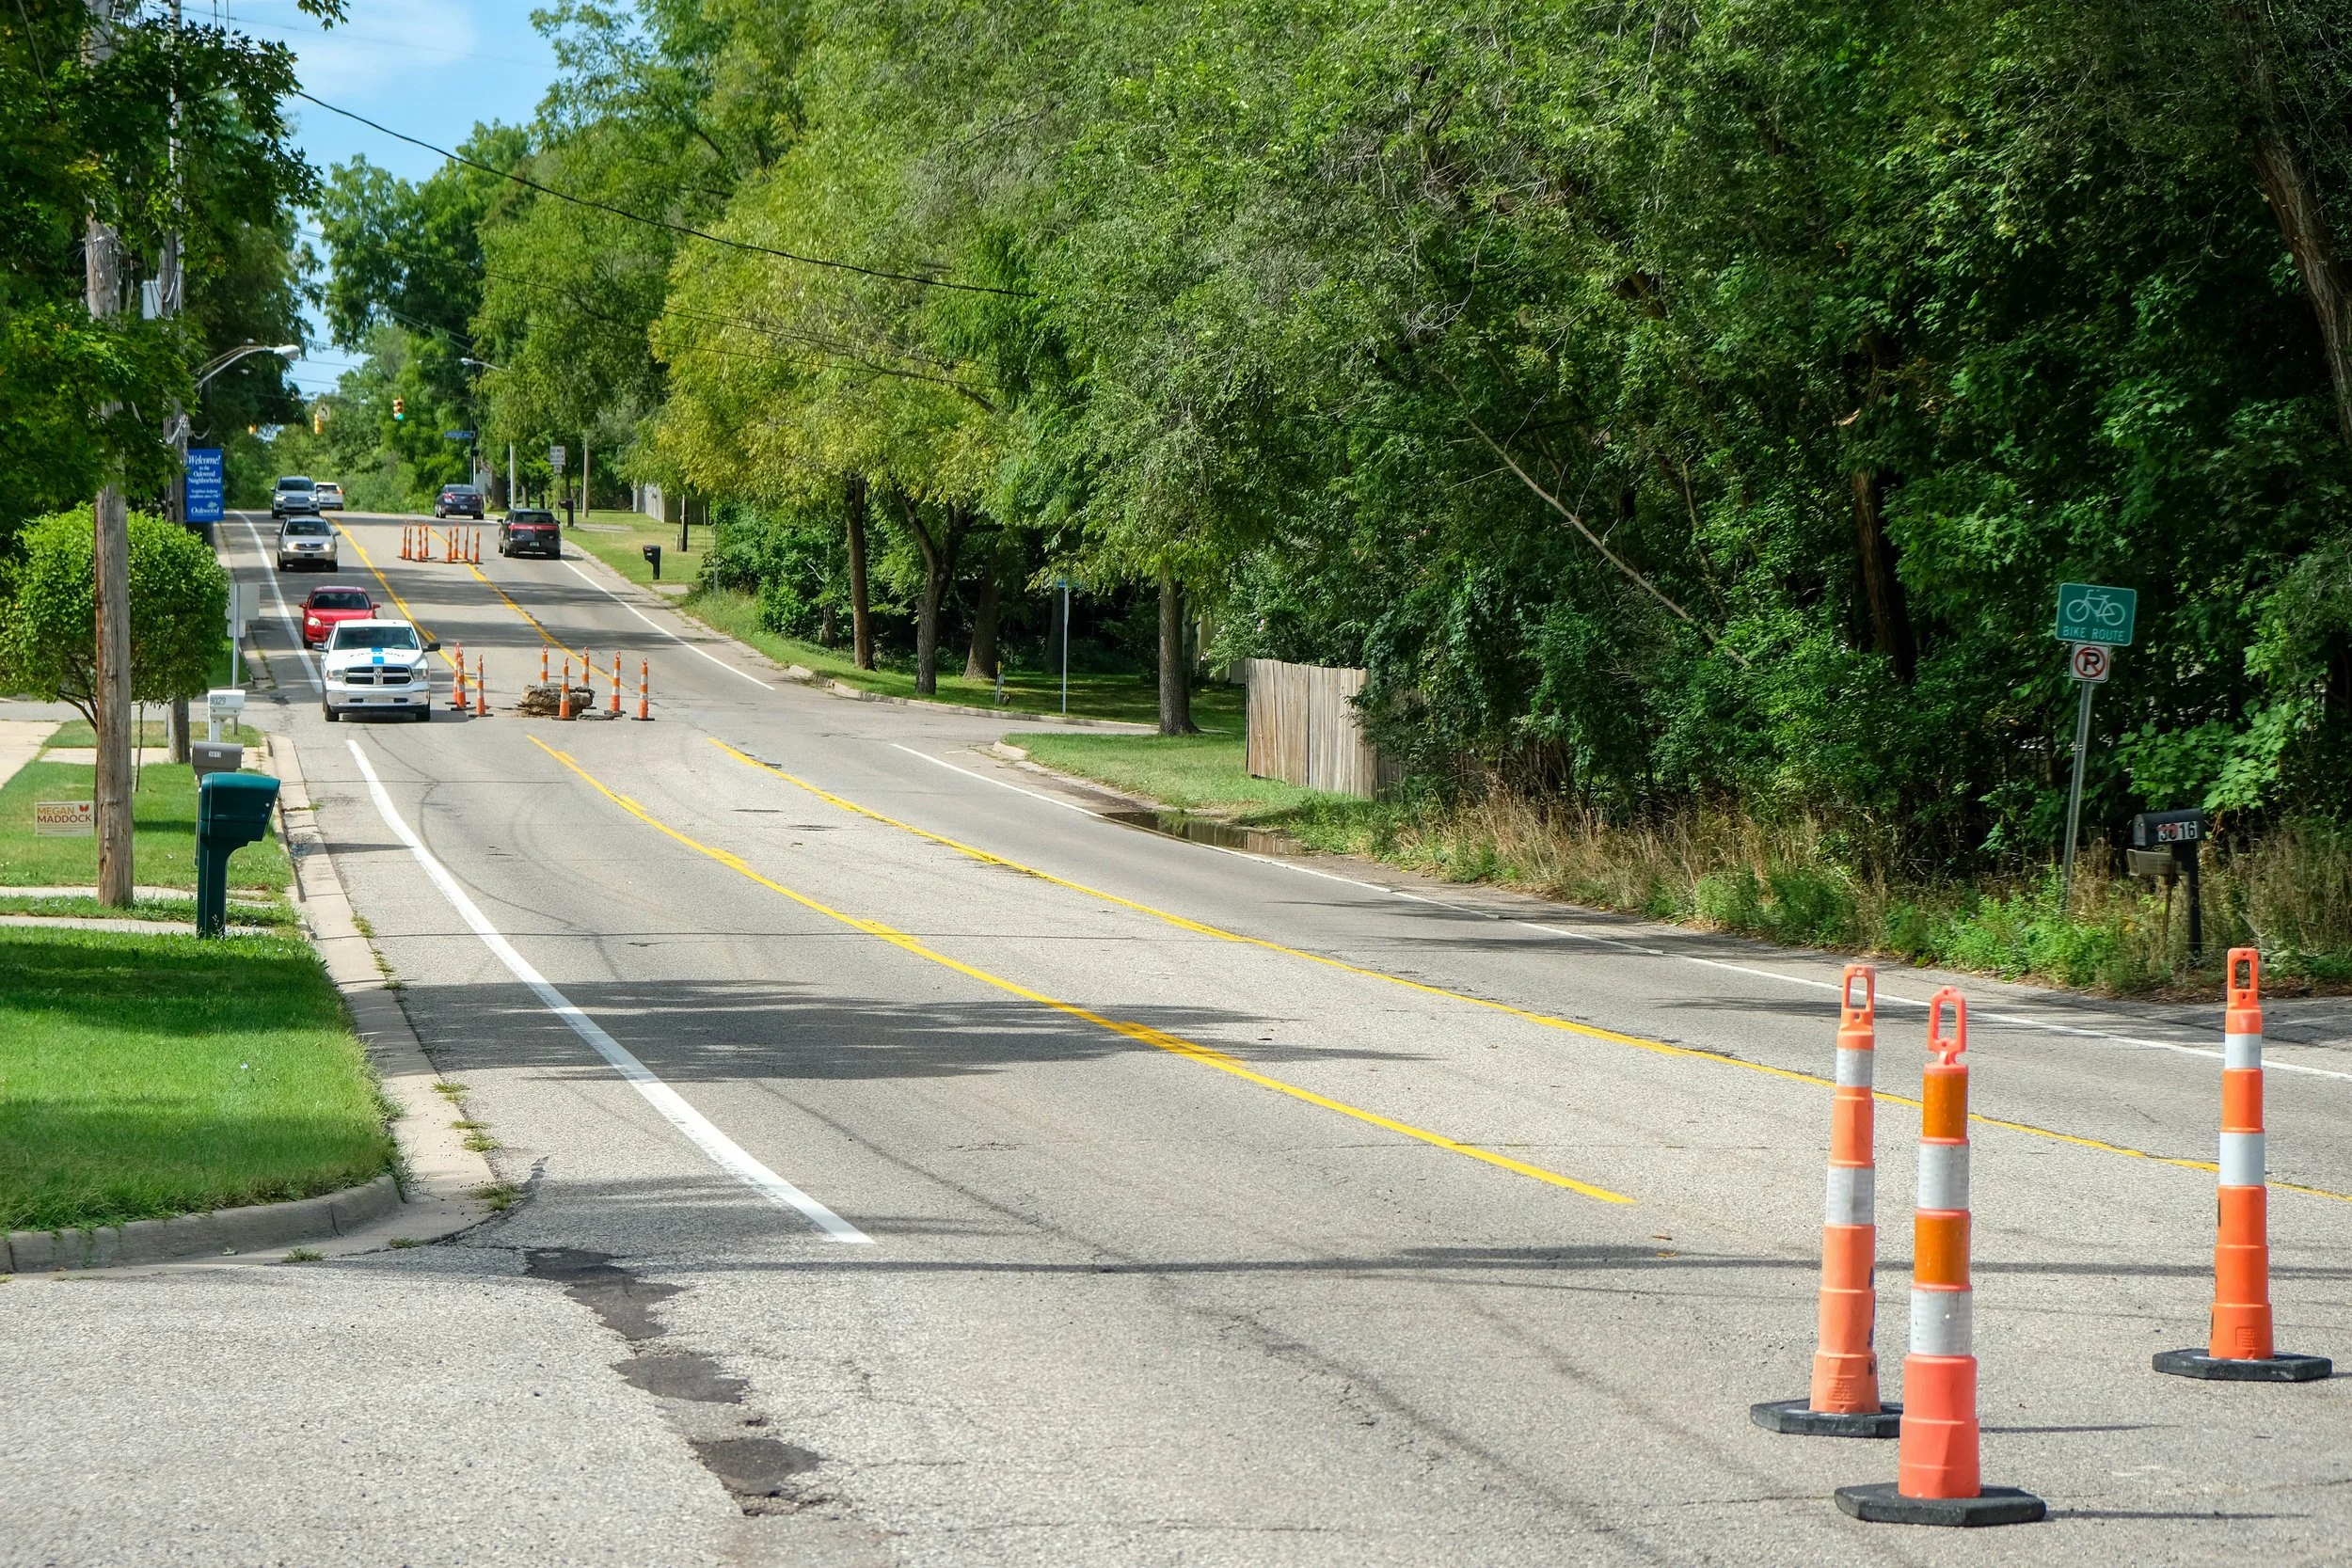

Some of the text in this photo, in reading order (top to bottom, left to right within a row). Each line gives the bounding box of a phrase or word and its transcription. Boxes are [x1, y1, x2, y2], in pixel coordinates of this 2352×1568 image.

[188, 454, 221, 465] Welcome!
[2062, 626, 2125, 641] BIKE ROUTE
[38, 806, 74, 815] MEGAN
[38, 814, 92, 823] MADDOCK
